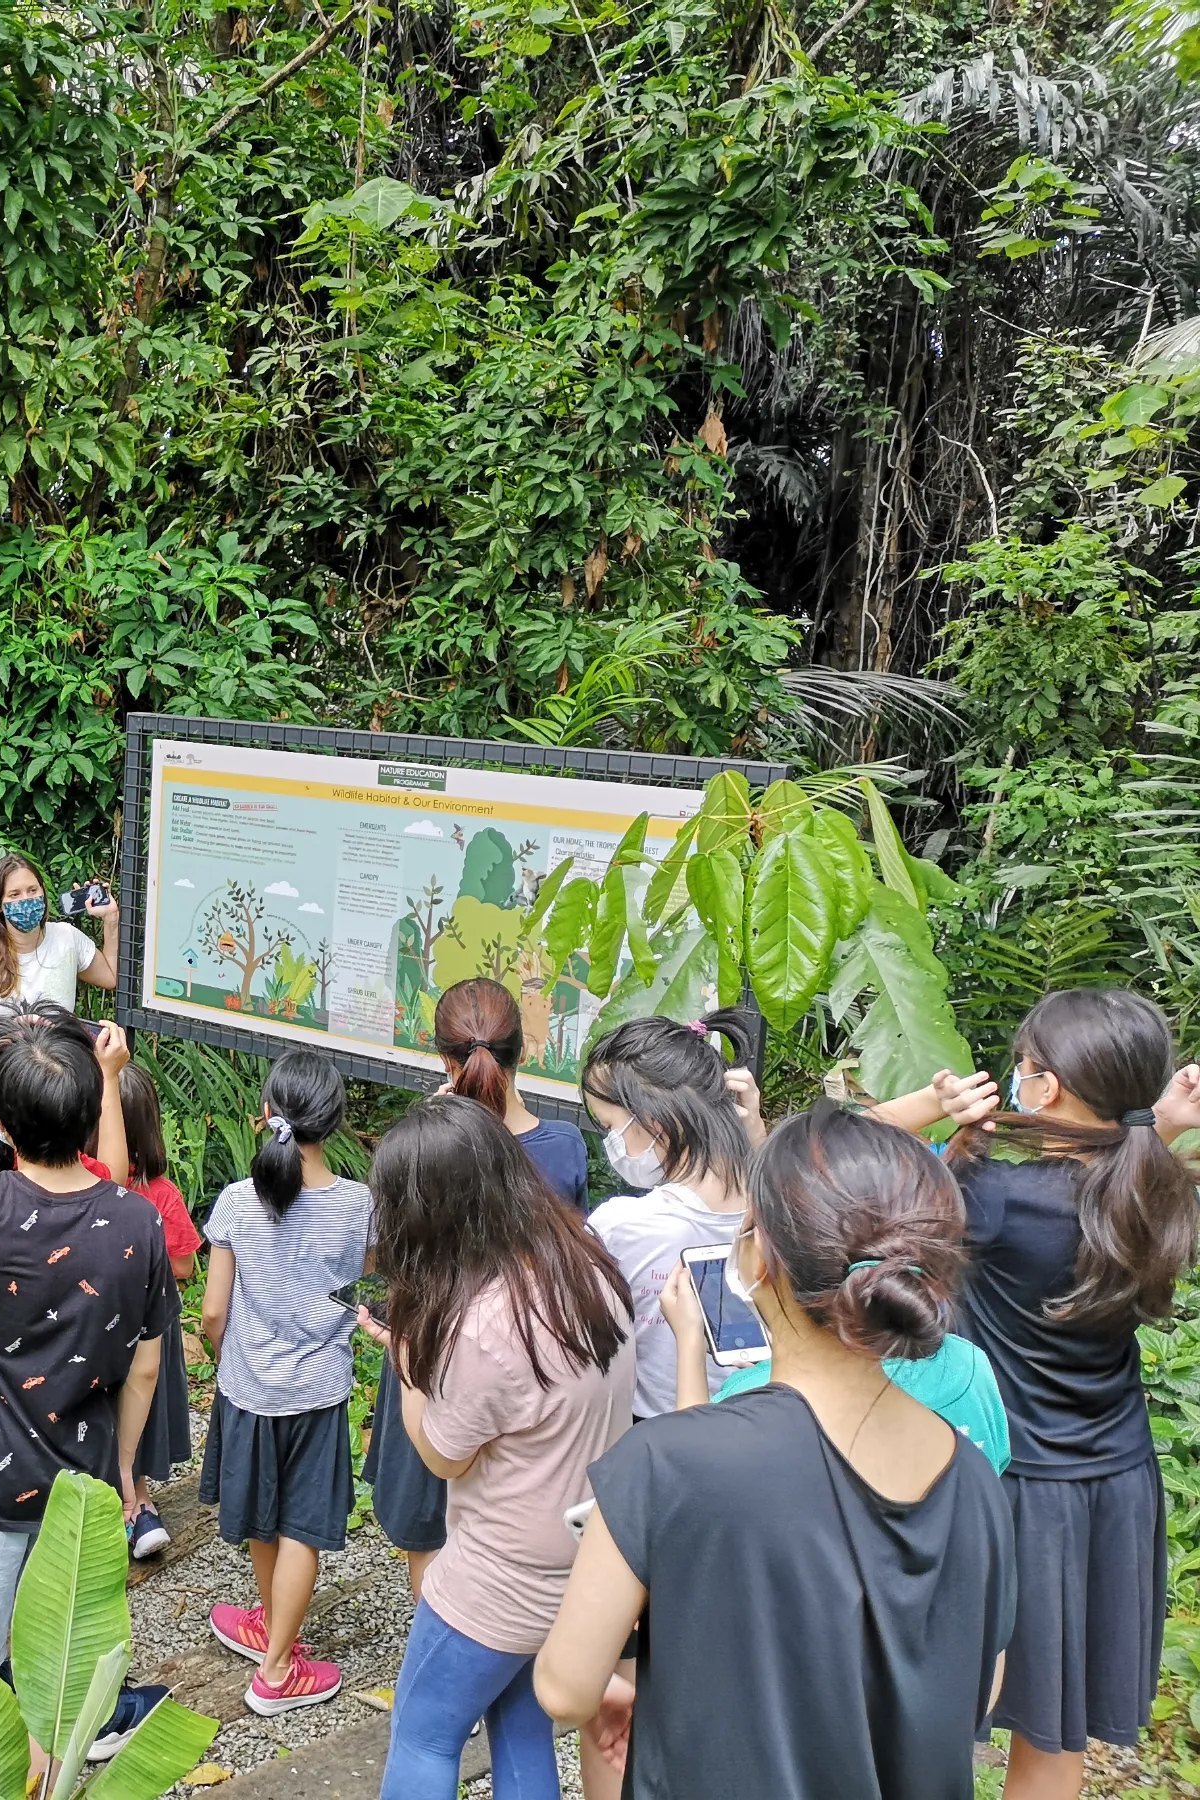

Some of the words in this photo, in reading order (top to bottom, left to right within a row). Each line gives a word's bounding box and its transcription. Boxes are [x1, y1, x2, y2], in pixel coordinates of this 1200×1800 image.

[380, 766, 405, 776] NATURE
[406, 768, 445, 779] EDUCATION
[393, 779, 430, 788] PROGRAMME
[332, 789, 363, 800] Wildlife
[366, 792, 401, 805] Habitat
[403, 797, 410, 806] &
[413, 797, 431, 807] Our
[433, 799, 494, 815] Environment
[552, 836, 565, 844] OUR
[585, 839, 595, 848] THE
[596, 840, 617, 850] TROPIC
[359, 872, 380, 881] CANOPY
[364, 941, 382, 949] CANOPY
[651, 1269, 669, 1280] Trus
